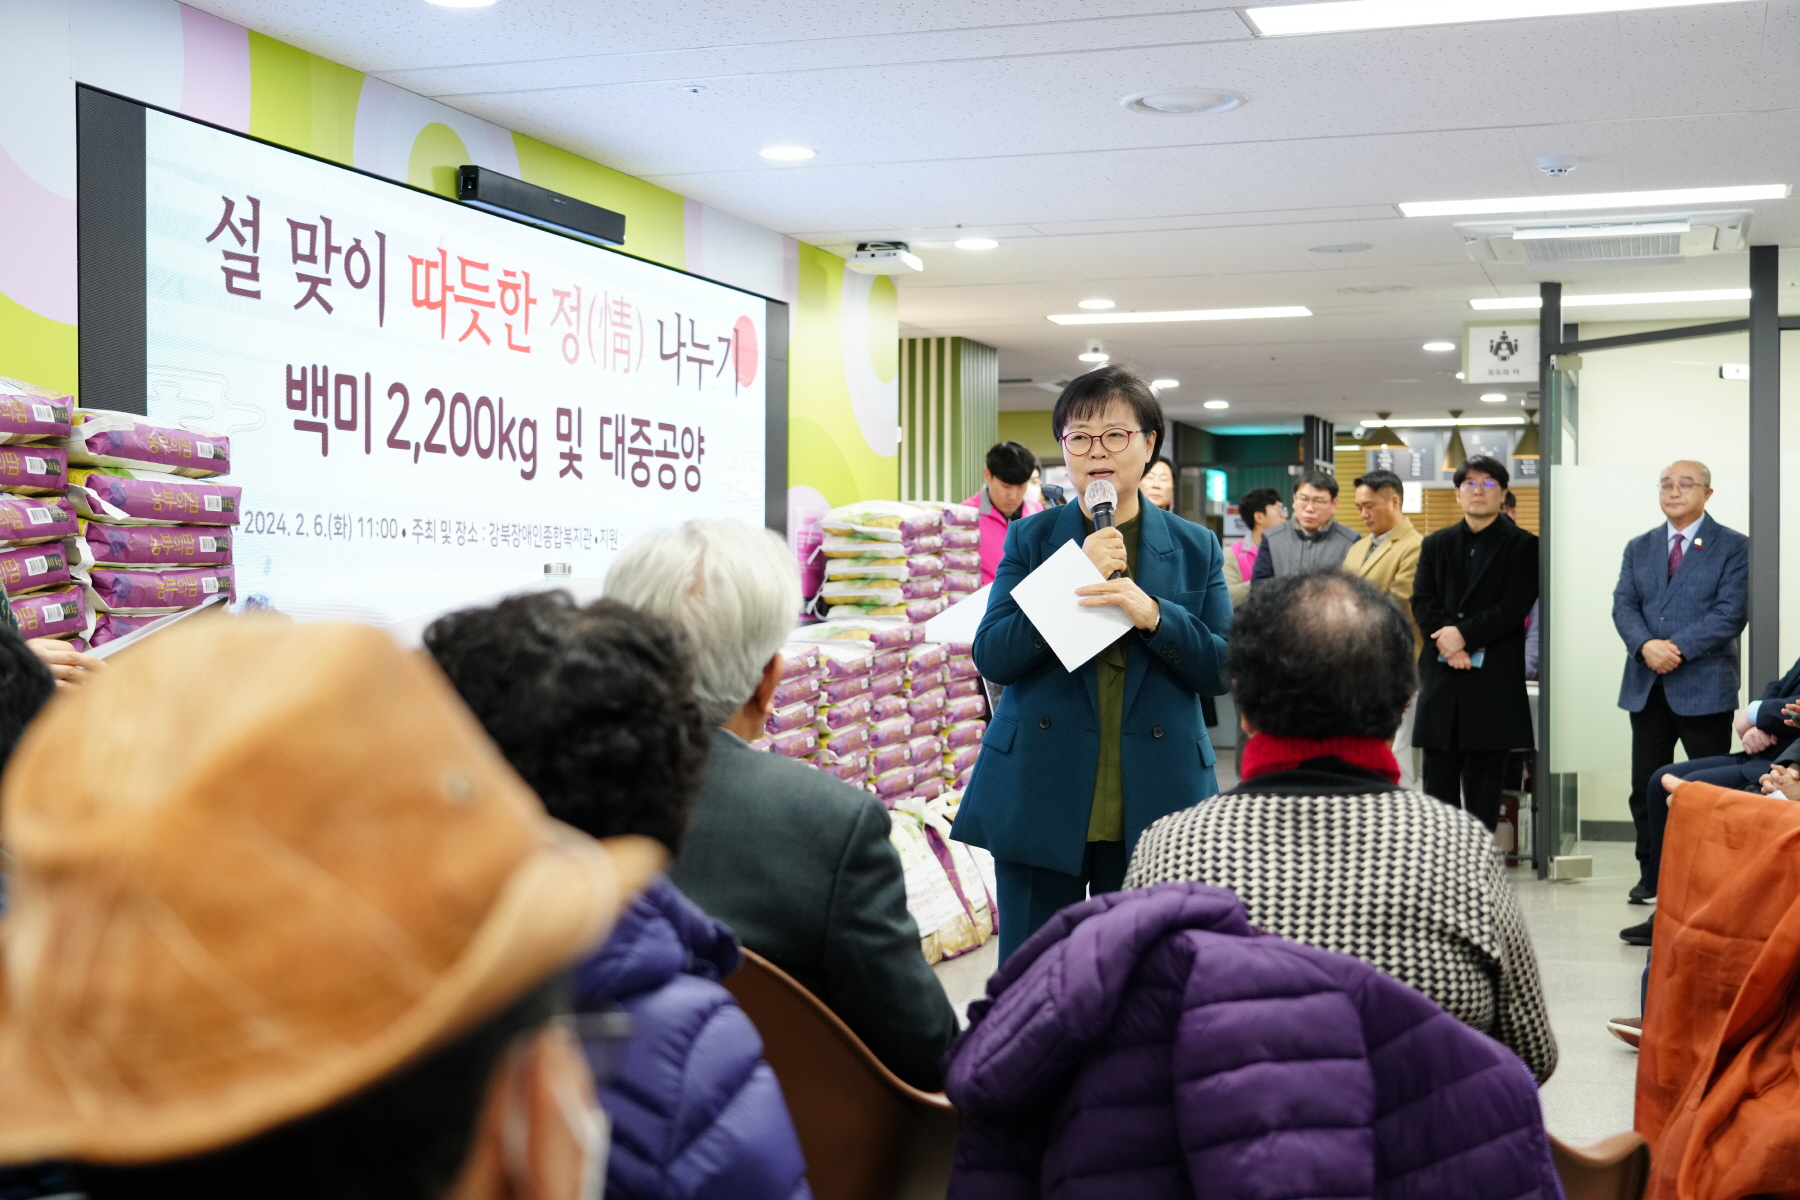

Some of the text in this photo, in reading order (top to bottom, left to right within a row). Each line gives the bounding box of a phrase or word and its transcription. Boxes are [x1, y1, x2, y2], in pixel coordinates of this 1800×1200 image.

[206, 195, 740, 398] 설 맞이 따듯한 정(情) 나누기
[286, 364, 705, 492] 백미 2,200kg 및 대중공양
[244, 511, 291, 537] 2024.
[295, 513, 309, 538] 2.
[412, 518, 436, 545] 주최
[440, 520, 452, 545] 및
[455, 520, 478, 546] 장소
[489, 522, 593, 550] 강북장애인종합복지관
[600, 528, 618, 551] 지원
